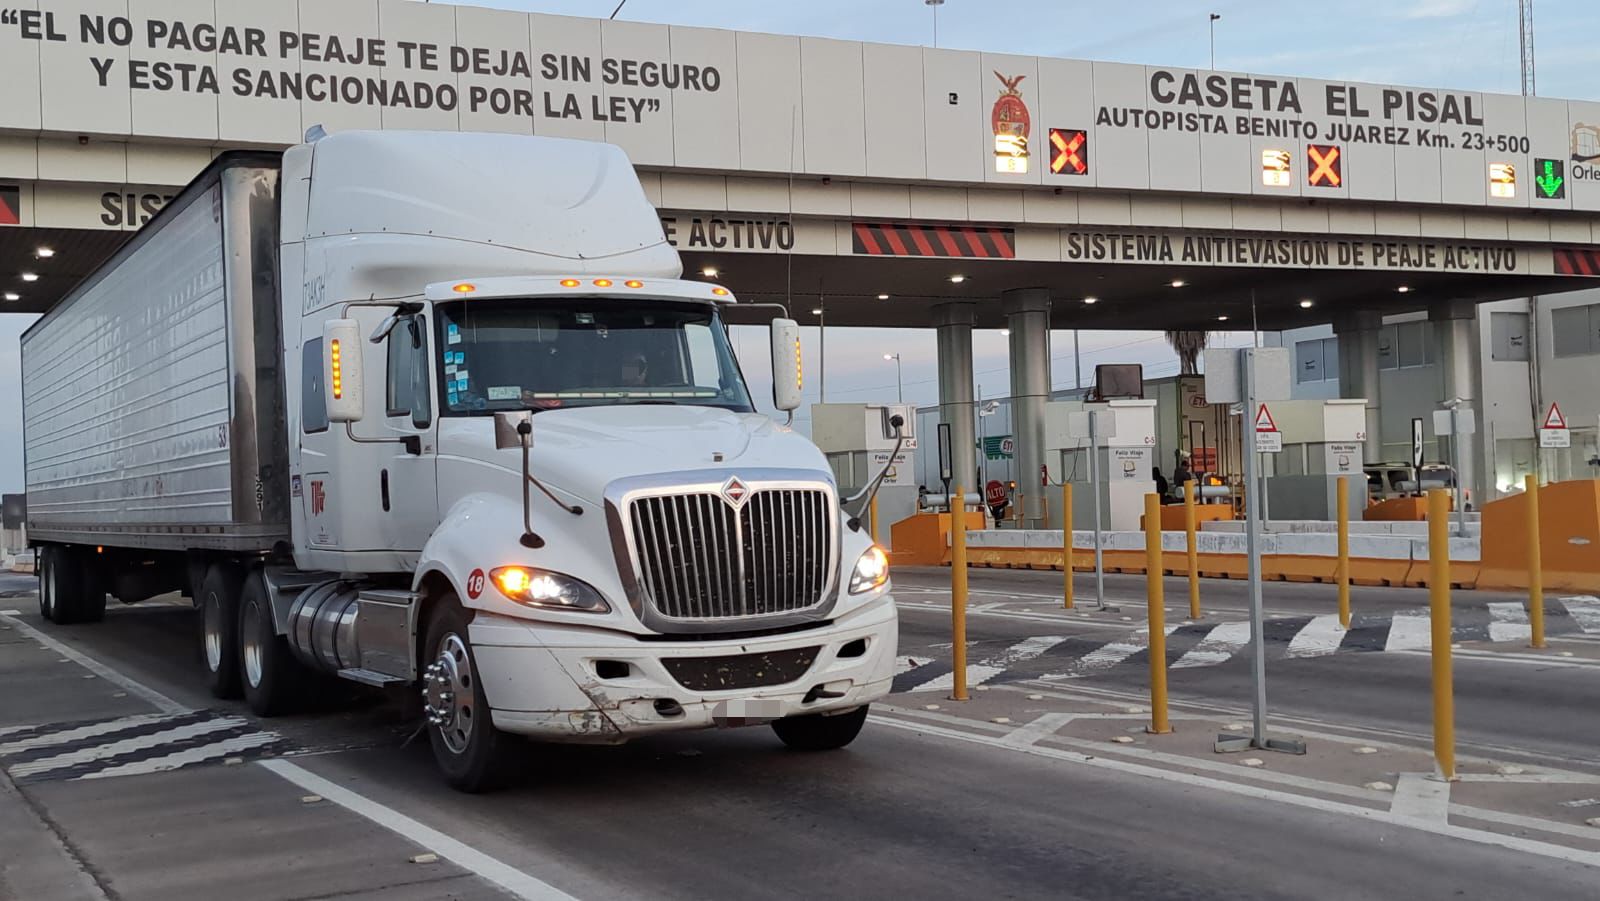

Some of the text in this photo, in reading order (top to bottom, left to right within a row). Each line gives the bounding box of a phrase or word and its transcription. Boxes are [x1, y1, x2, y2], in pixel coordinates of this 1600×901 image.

[79, 14, 133, 47] NO
[147, 19, 267, 57] PAGAR
[279, 31, 386, 67] PEAJE
[397, 41, 438, 71] TE
[450, 46, 531, 78] DEJA
[540, 53, 591, 83] SIN
[602, 58, 721, 92] SEGURO
[89, 57, 114, 87] Y
[129, 60, 220, 94] ESTA
[232, 68, 457, 112] SANCIONADO
[470, 86, 533, 116] POR
[544, 92, 582, 119] LA
[1150, 70, 1483, 126] CASETA EL PISAL
[1096, 106, 1530, 154] AUTOPISTA BENITO JUAREZ Km. 23+500
[101, 192, 174, 226] SIS
[689, 218, 795, 250] ACTIVO
[1067, 232, 1517, 272] SISTEMA ANTIEVASION DE PEAJE ACTIVO
[469, 575, 483, 593] 18
